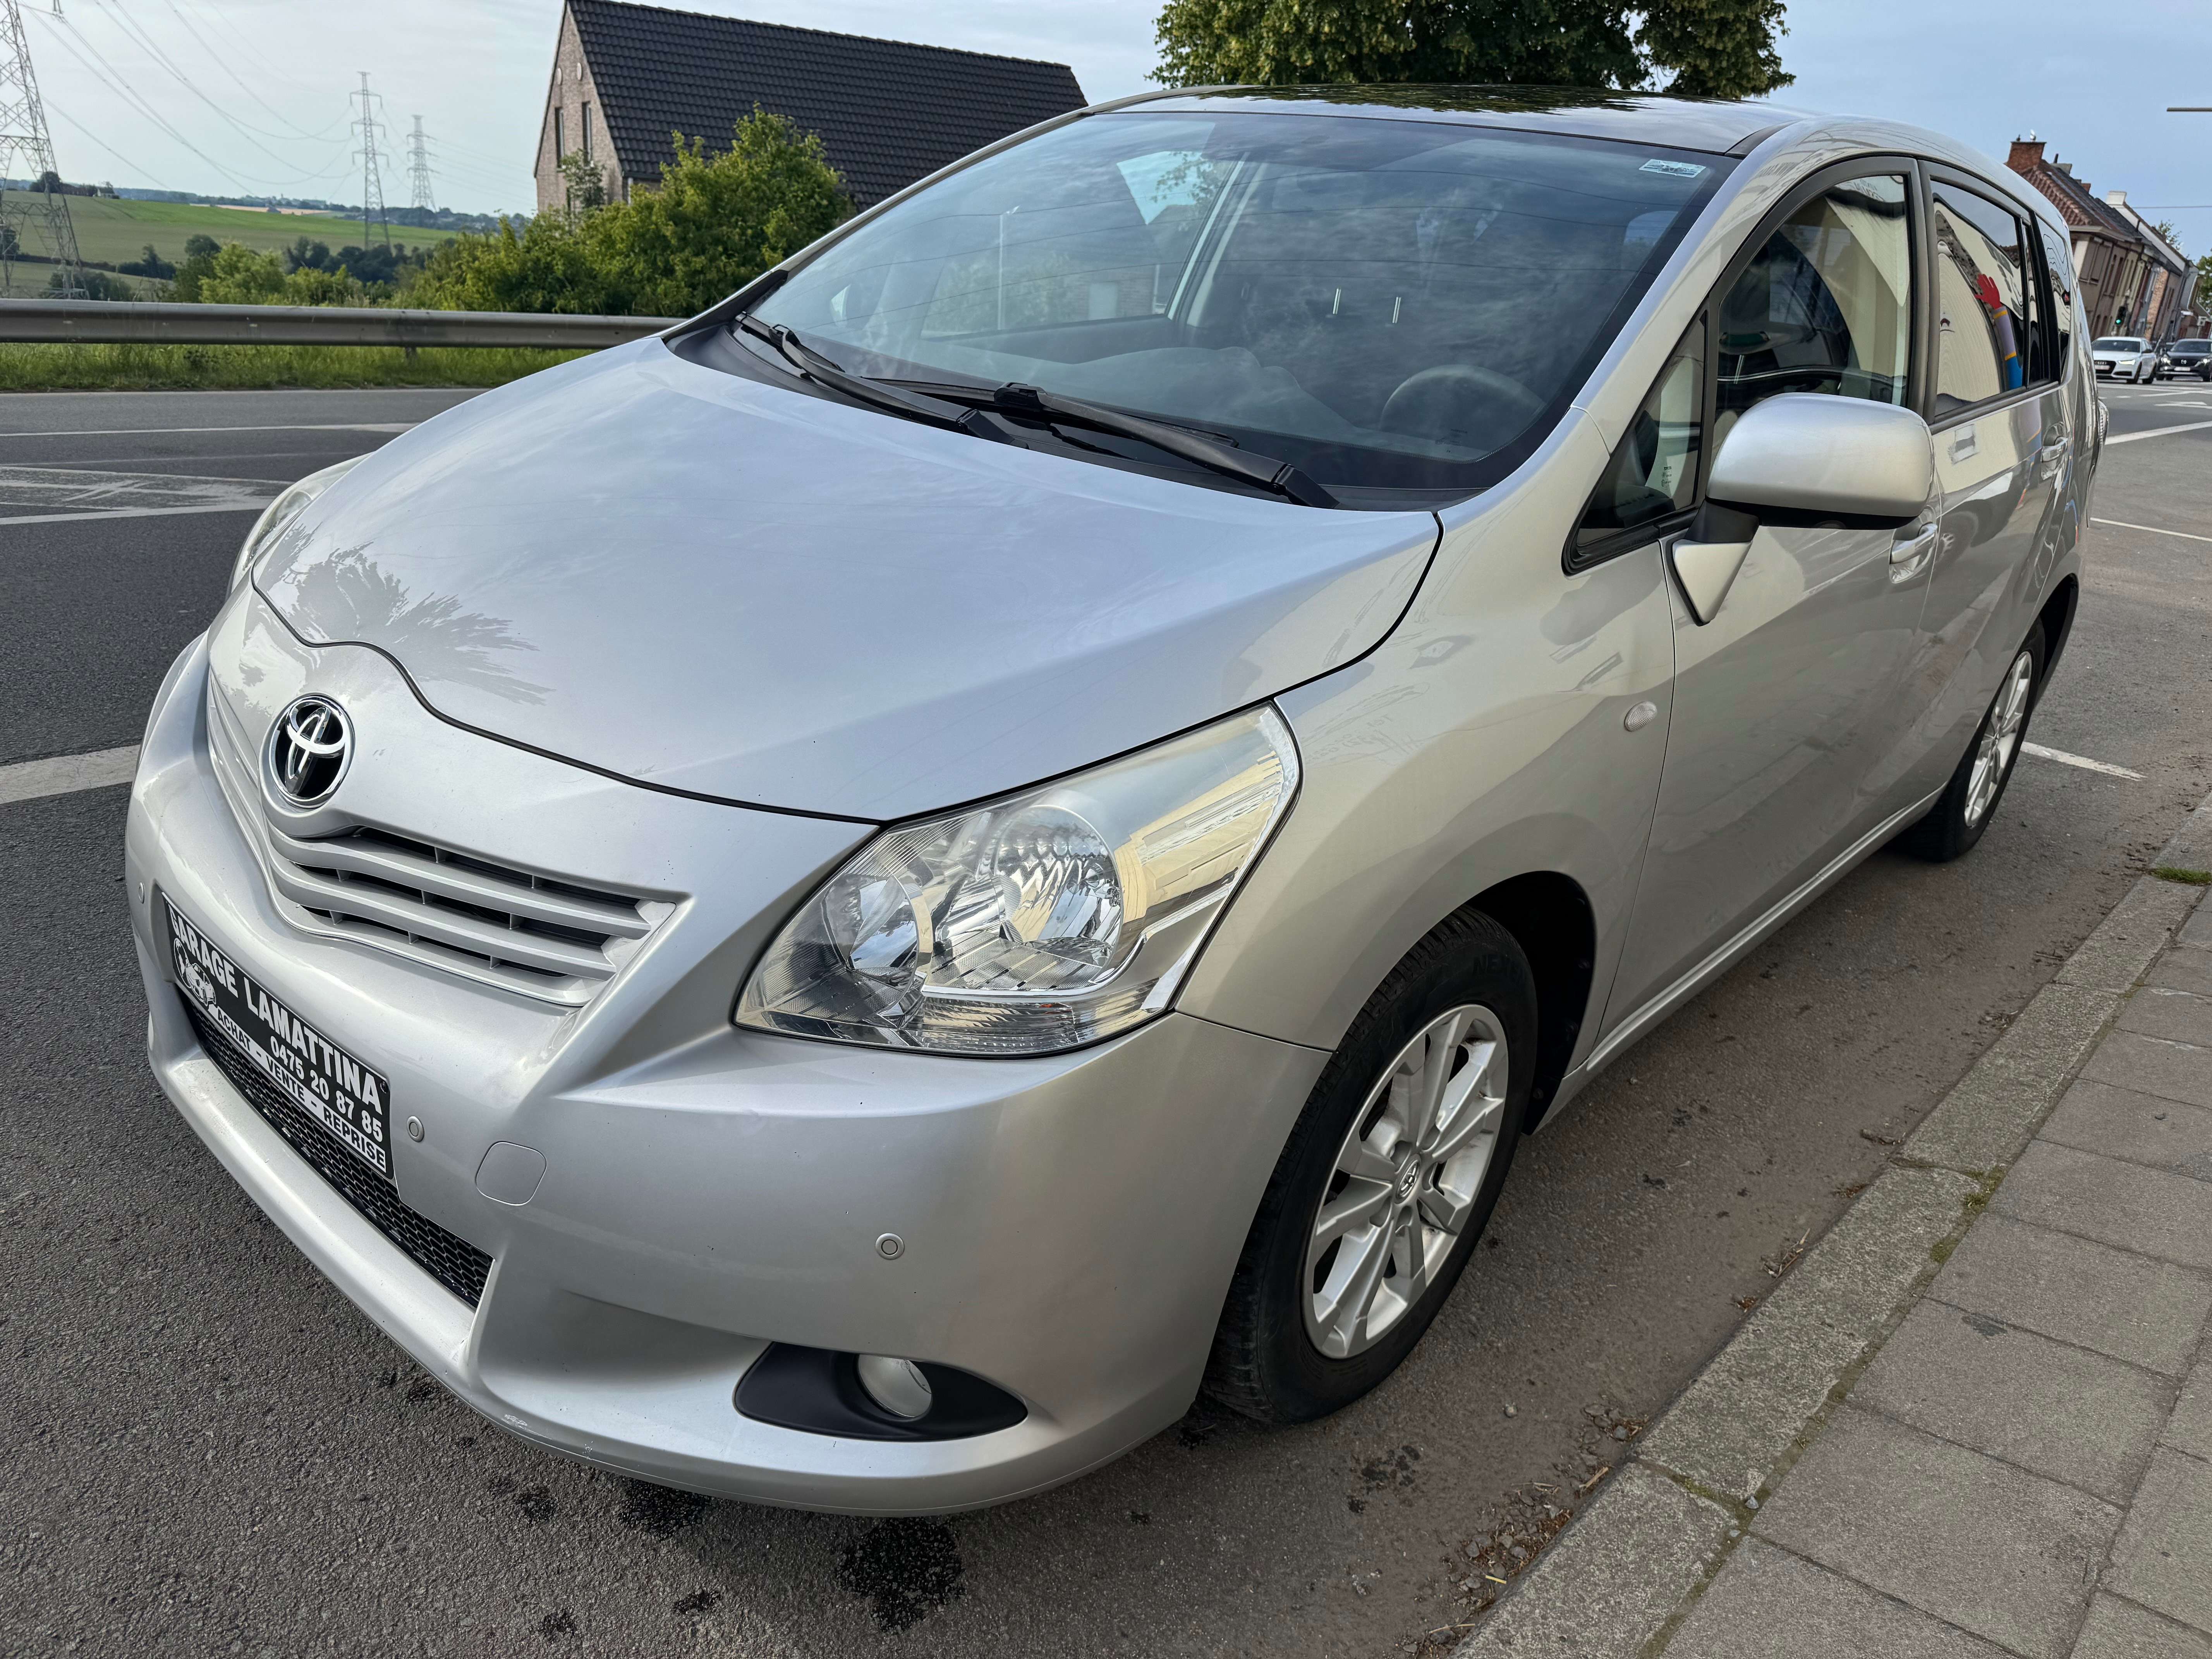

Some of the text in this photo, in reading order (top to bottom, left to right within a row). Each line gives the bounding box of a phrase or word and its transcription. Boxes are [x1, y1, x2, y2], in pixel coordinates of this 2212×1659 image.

[168, 904, 383, 1115] GARAGE LAMATTINA
[218, 1008, 251, 1051] ACHAT
[266, 1054, 305, 1102] VENTE
[323, 1105, 385, 1169] REPRISE
[270, 1036, 383, 1142] 0475 20 87 85
